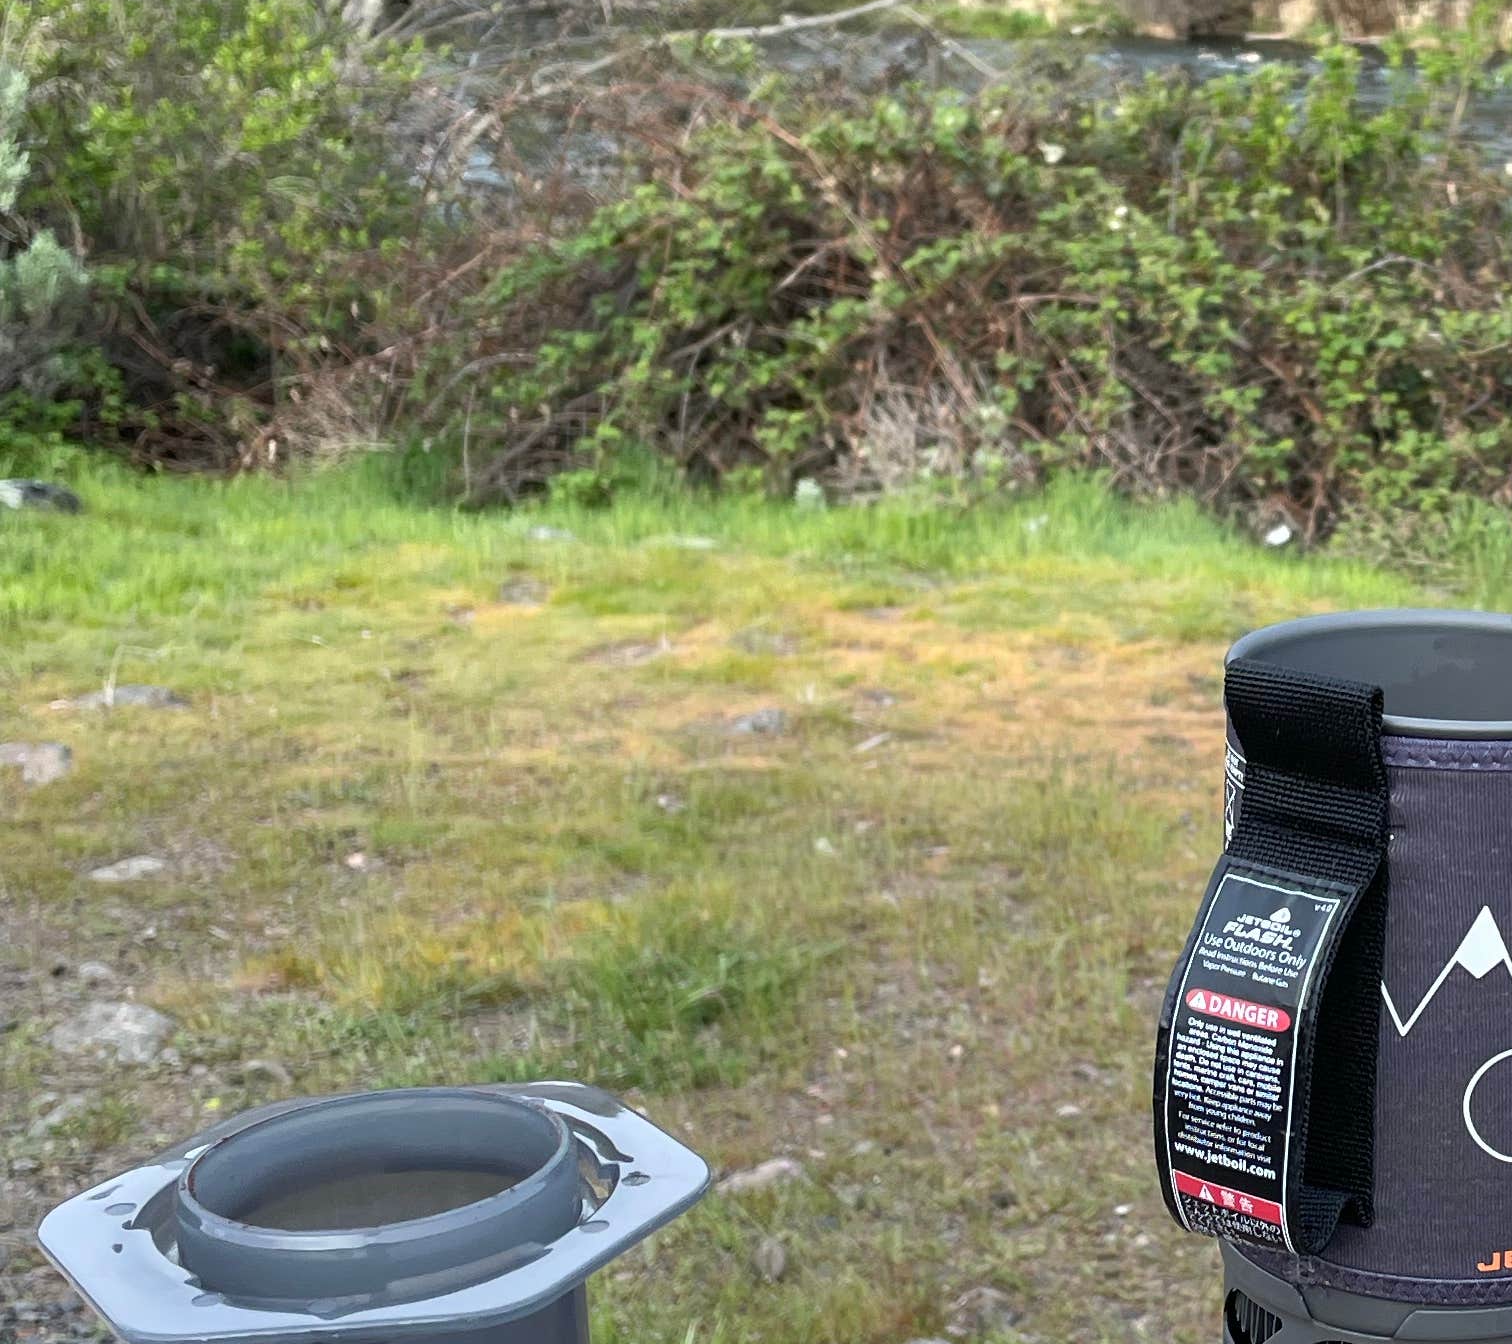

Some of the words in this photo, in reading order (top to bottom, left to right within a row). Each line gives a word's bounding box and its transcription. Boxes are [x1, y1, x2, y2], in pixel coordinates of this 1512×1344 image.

[1198, 946, 1217, 958] Read
[1258, 961, 1283, 975] Before
[1284, 967, 1298, 978] Use
[1204, 932, 1223, 948] Use
[1224, 937, 1277, 961] Outdoors
[1278, 951, 1307, 970] Only
[1188, 1017, 1204, 1029] Only
[1208, 995, 1279, 1028] DANGER
[1174, 1141, 1276, 1180] www.jetboil.com
